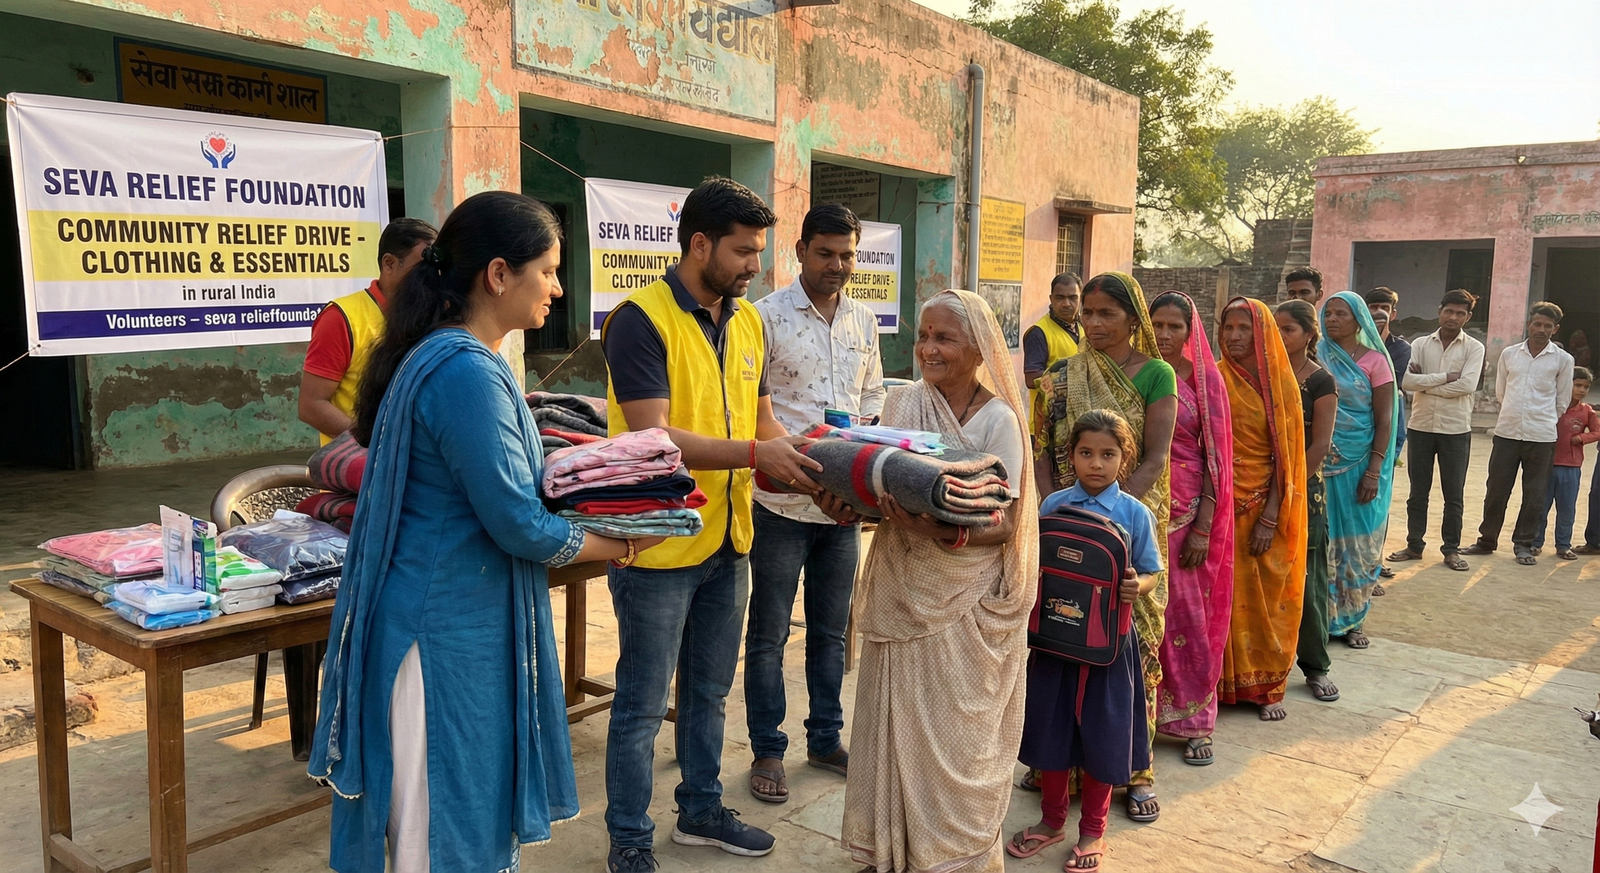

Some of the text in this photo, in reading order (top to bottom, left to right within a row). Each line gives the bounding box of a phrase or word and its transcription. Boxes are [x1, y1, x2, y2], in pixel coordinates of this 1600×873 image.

[129, 50, 178, 90] सेवा
[276, 83, 320, 115] शाल
[43, 167, 366, 209] SEVA RELIEF FOUNDATION
[57, 217, 209, 245] COMMUNITY
[217, 223, 288, 246] RELIEF
[295, 225, 352, 247] DRIVE
[598, 221, 631, 241] SEVA
[634, 224, 673, 243] RELIEF
[81, 250, 350, 275] CLOTHING & ESSENTIALS
[602, 252, 670, 270] COMMUNITY
[850, 272, 872, 285] RELIEF
[872, 274, 890, 286] DRIVE
[182, 284, 276, 301] in rural India
[851, 287, 888, 300] ESSENTIALS
[106, 312, 187, 330] Volunteers
[204, 314, 237, 326] seva
